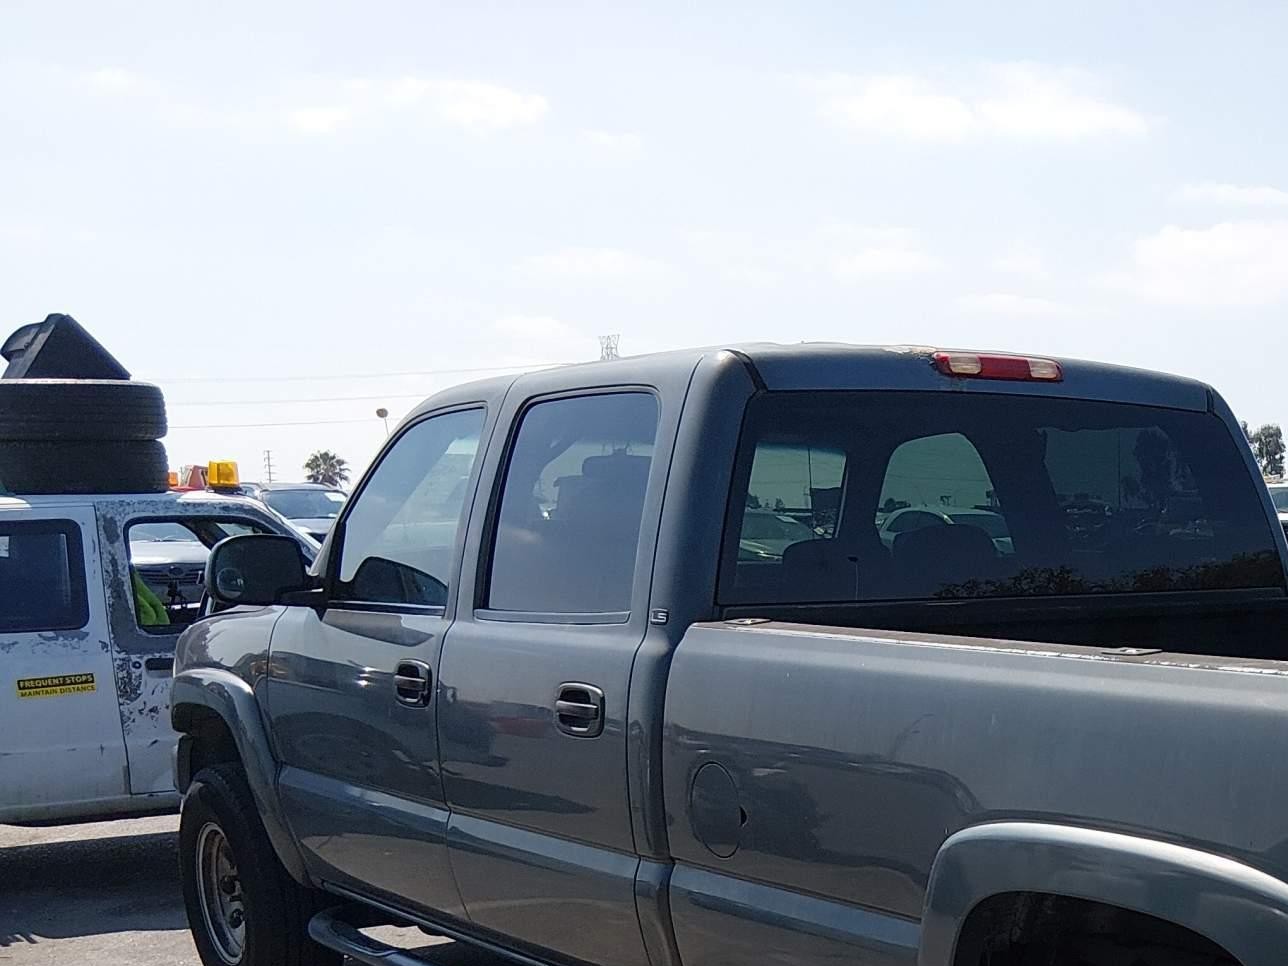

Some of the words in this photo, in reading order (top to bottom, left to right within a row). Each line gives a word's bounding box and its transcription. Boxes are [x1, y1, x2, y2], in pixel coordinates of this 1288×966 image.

[20, 677, 64, 688] FREQUENT
[65, 674, 93, 684] STOPS
[21, 689, 58, 697] MAINTAIN
[60, 685, 96, 694] DISTANCE
